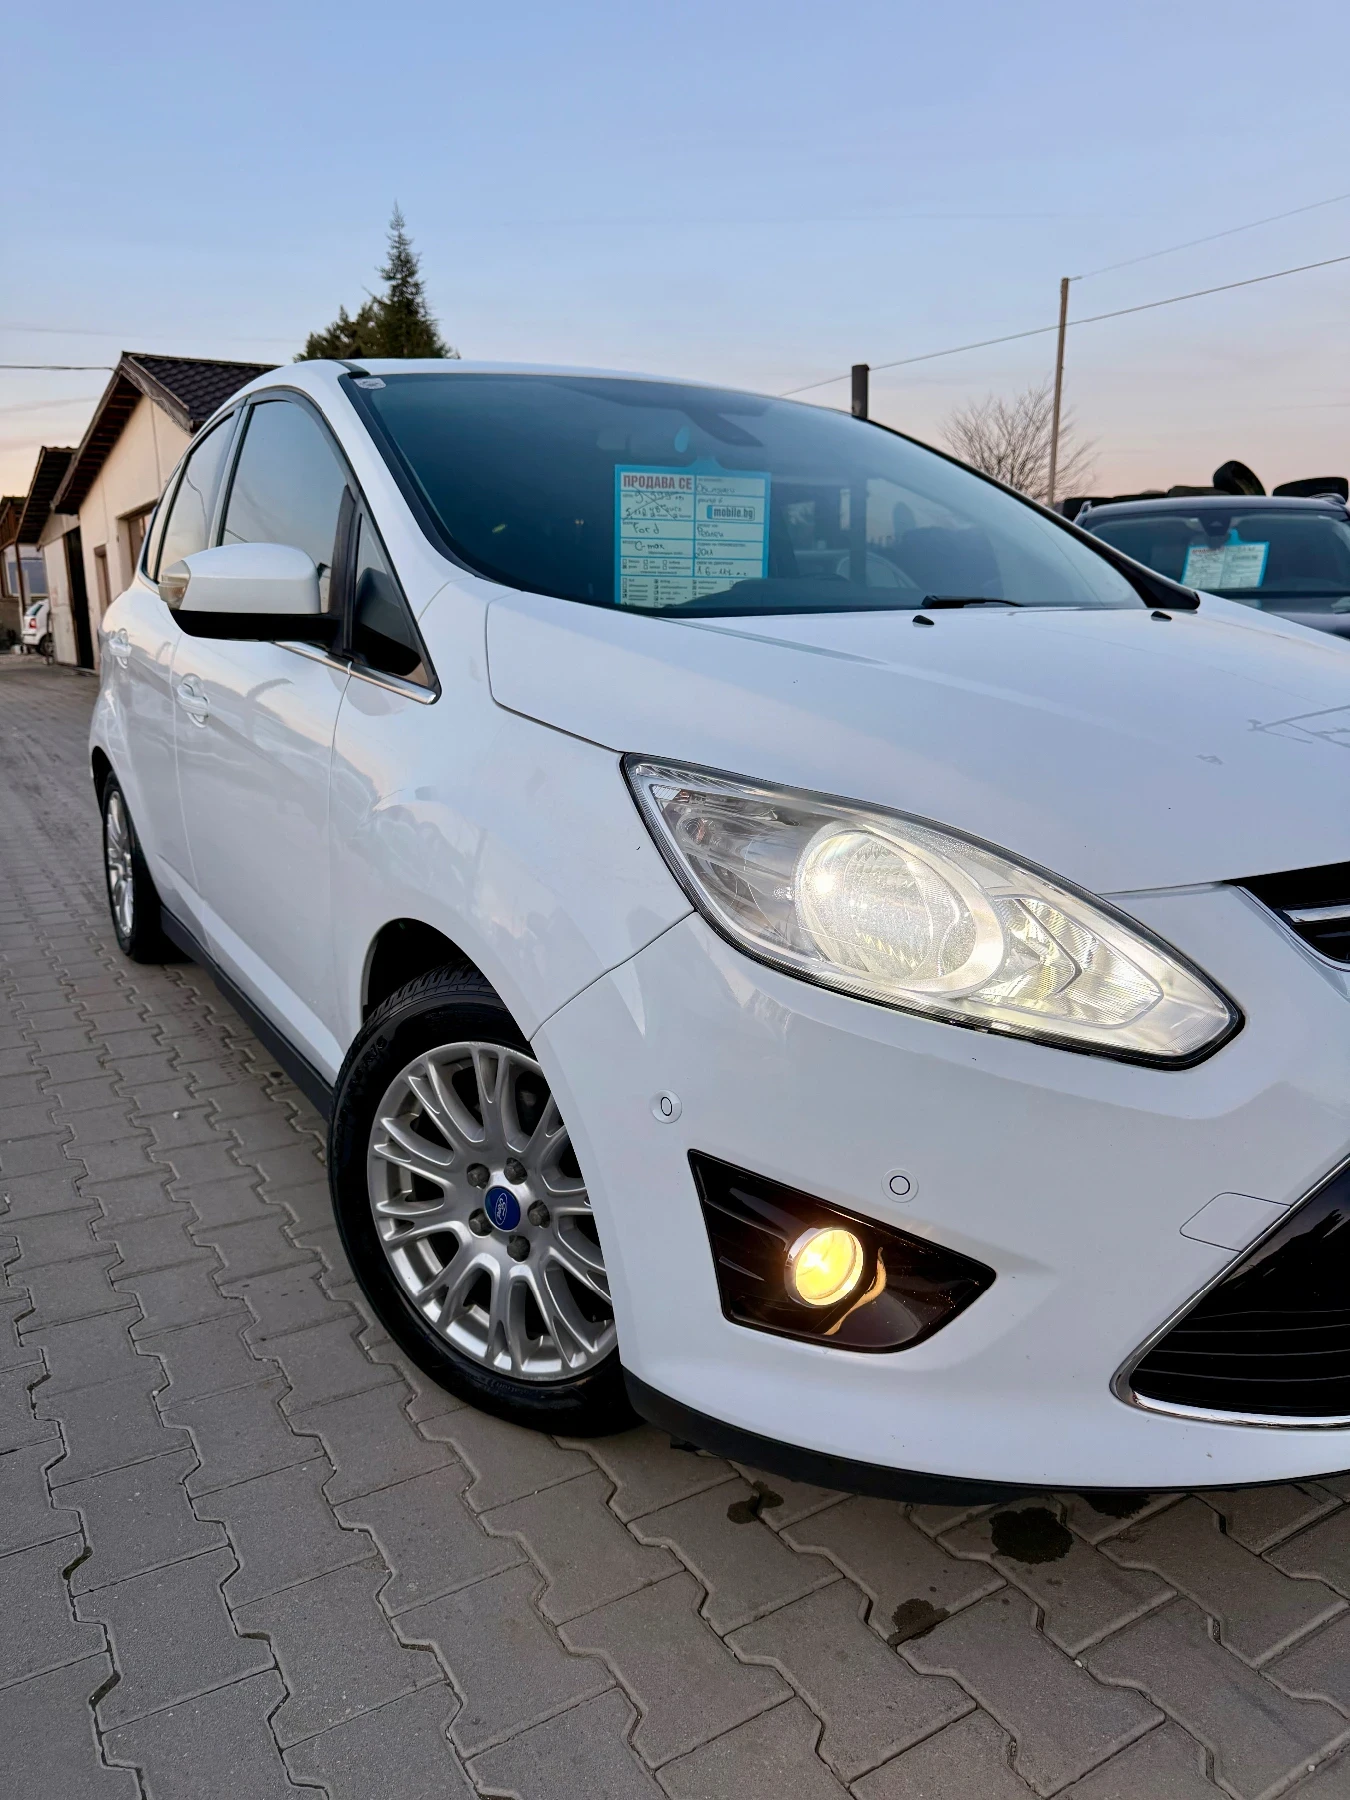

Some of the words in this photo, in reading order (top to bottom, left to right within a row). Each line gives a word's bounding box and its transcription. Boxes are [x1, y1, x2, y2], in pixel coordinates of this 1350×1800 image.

[623, 474, 676, 490] ПРОДАВА
[679, 476, 693, 490] СЕ
[713, 507, 754, 519] mobile.bg
[632, 521, 660, 535] Ford
